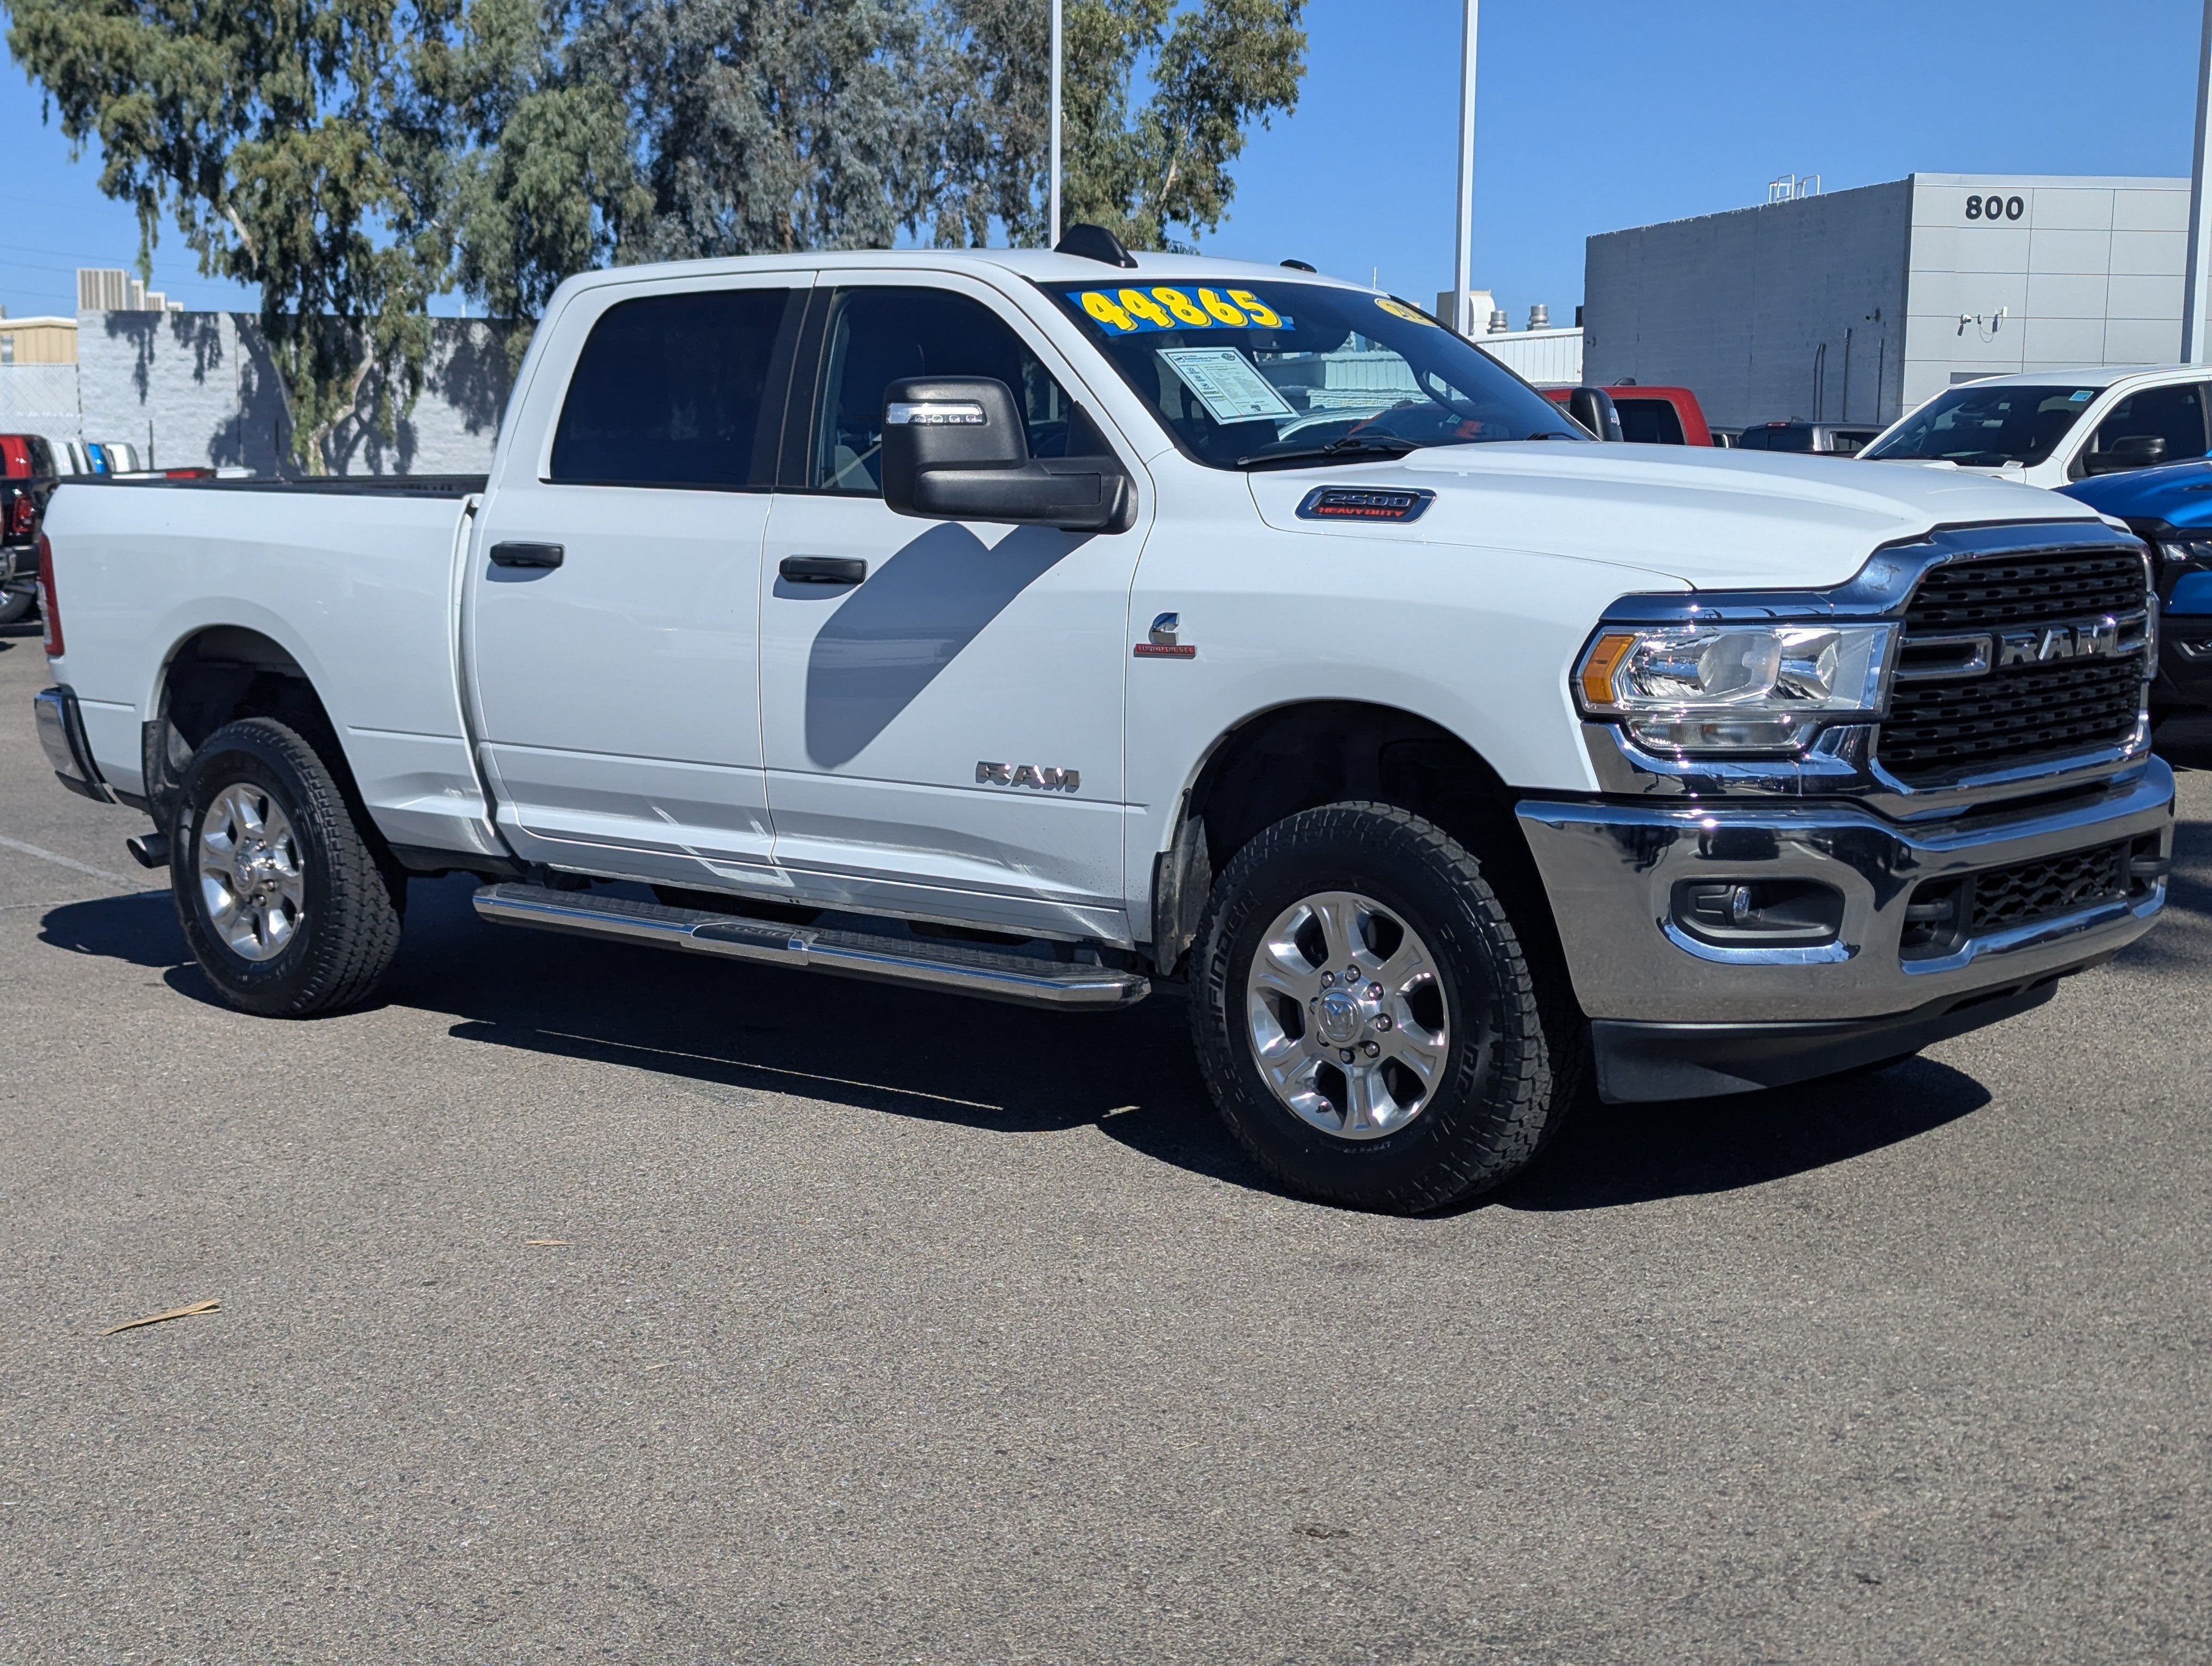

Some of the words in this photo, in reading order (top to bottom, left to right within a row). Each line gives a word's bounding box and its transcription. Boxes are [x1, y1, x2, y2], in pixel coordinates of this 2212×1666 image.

[1965, 195, 2024, 221] 800
[1081, 286, 1283, 331] 44865
[1319, 506, 1364, 515] HEAVY
[1365, 508, 1405, 517] DUTY
[1325, 493, 1411, 507] 2500
[1999, 623, 2116, 665] RAM
[975, 760, 1081, 793] RAM
